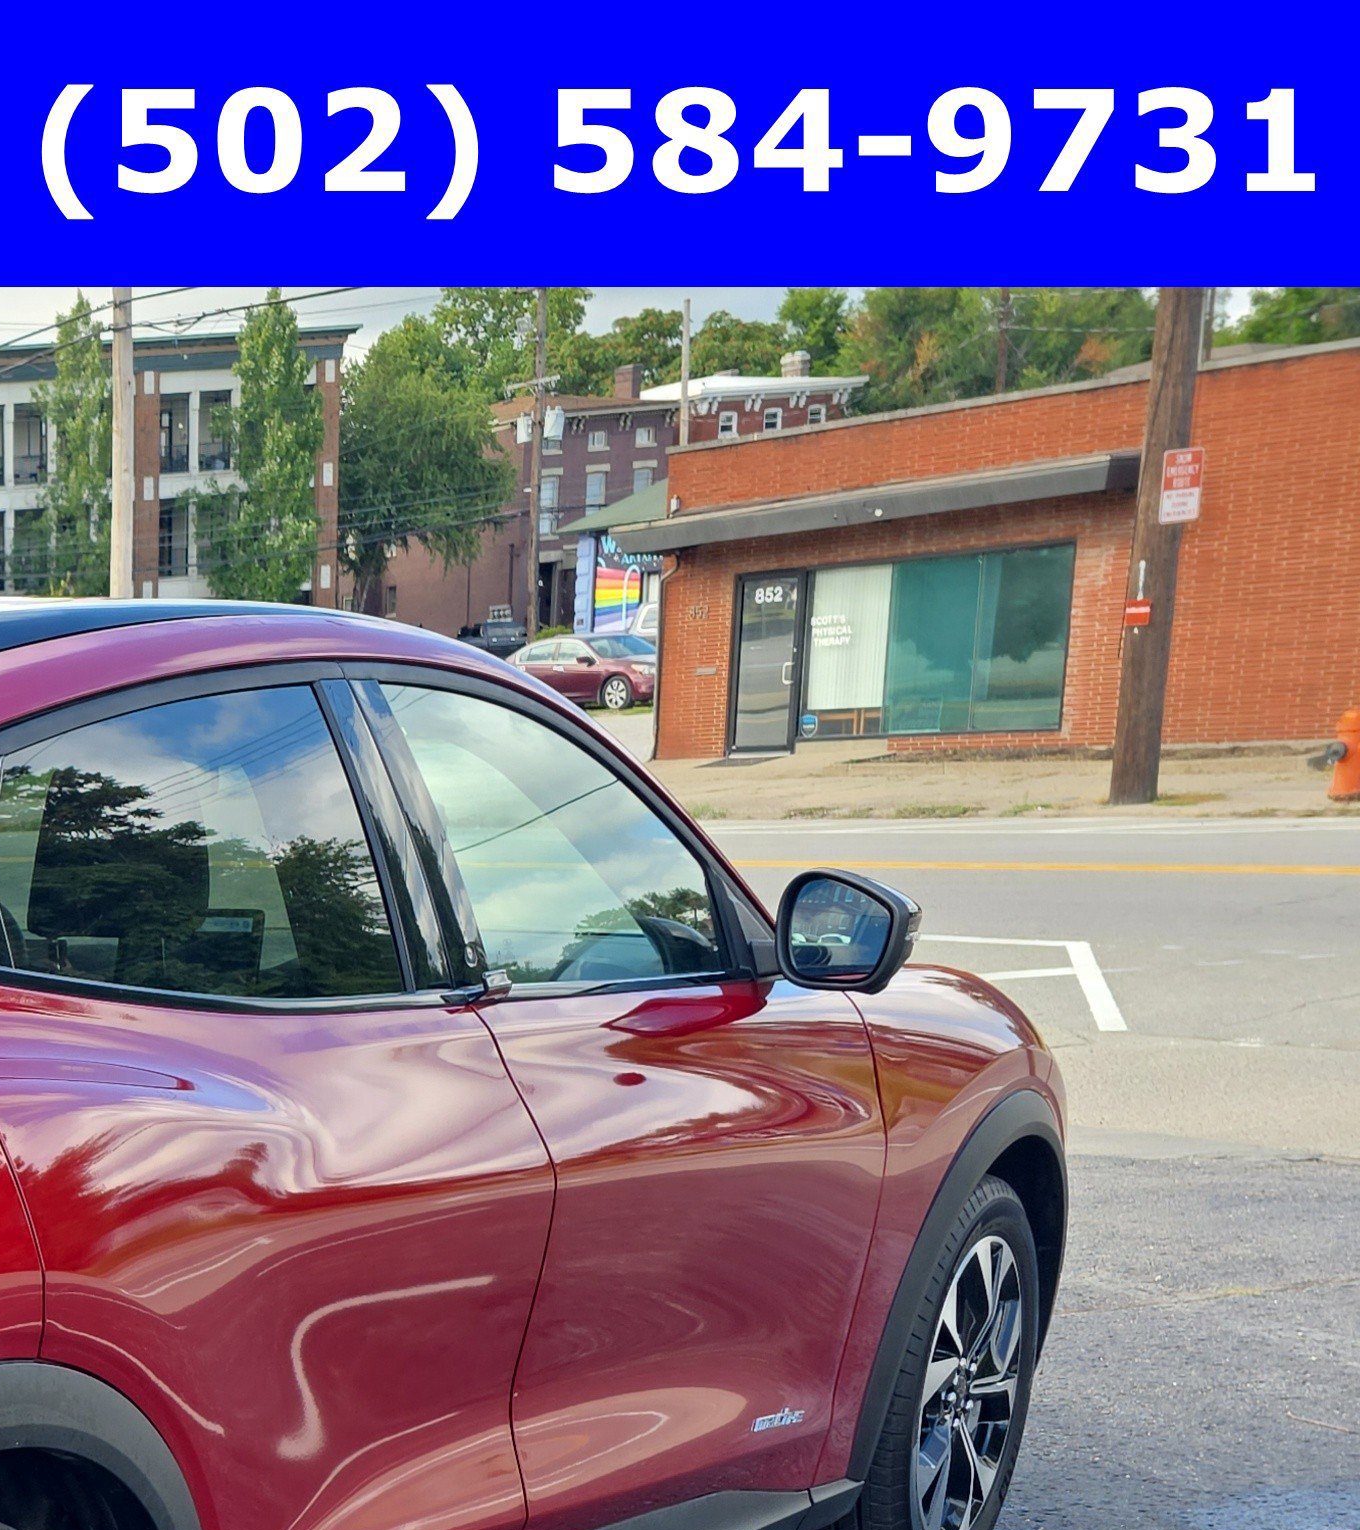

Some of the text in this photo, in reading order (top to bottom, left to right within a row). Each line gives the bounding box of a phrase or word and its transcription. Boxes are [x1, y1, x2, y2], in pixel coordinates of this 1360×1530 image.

[755, 586, 783, 605] 852
[812, 625, 854, 637] PHYSICAL
[814, 635, 851, 648] THERAPY
